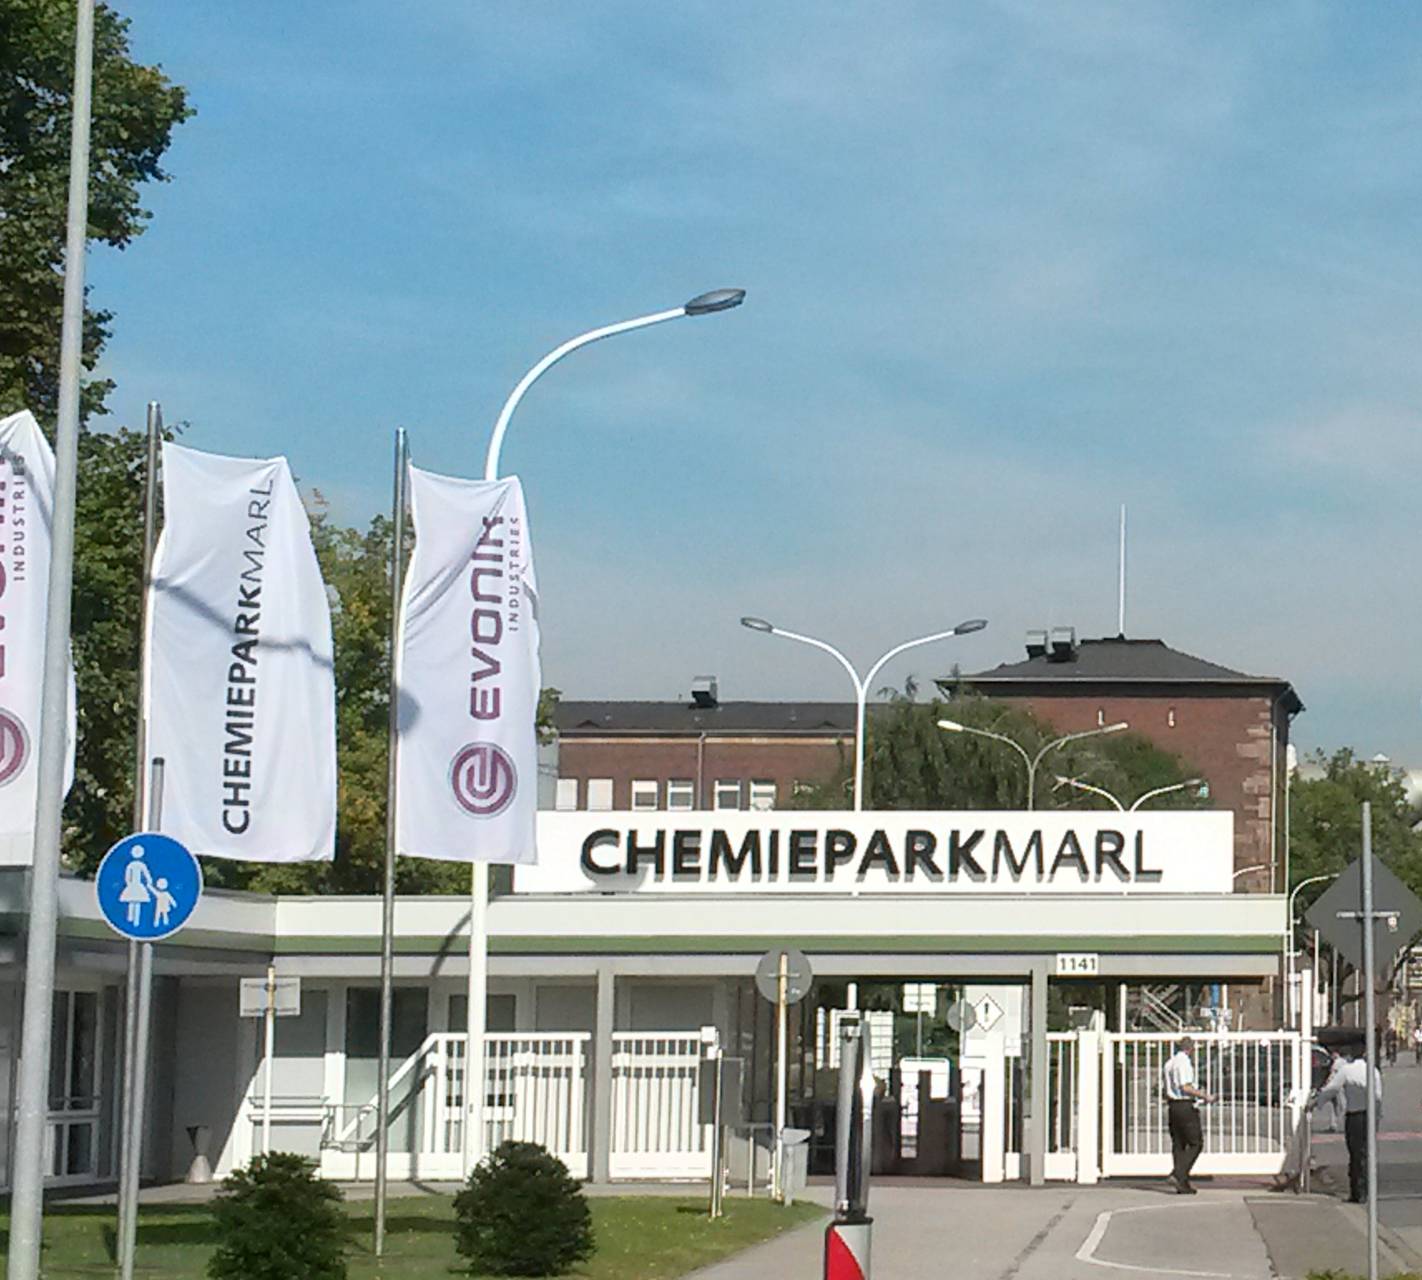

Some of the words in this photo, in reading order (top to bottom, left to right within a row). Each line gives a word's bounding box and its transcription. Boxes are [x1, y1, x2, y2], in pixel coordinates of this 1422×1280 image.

[13, 454, 25, 581] INDUSTRIES
[222, 479, 274, 835] CHEMIEPARKMARL
[580, 829, 1163, 879] CHEMIEPARKMARL
[1060, 957, 1096, 971] 1141
